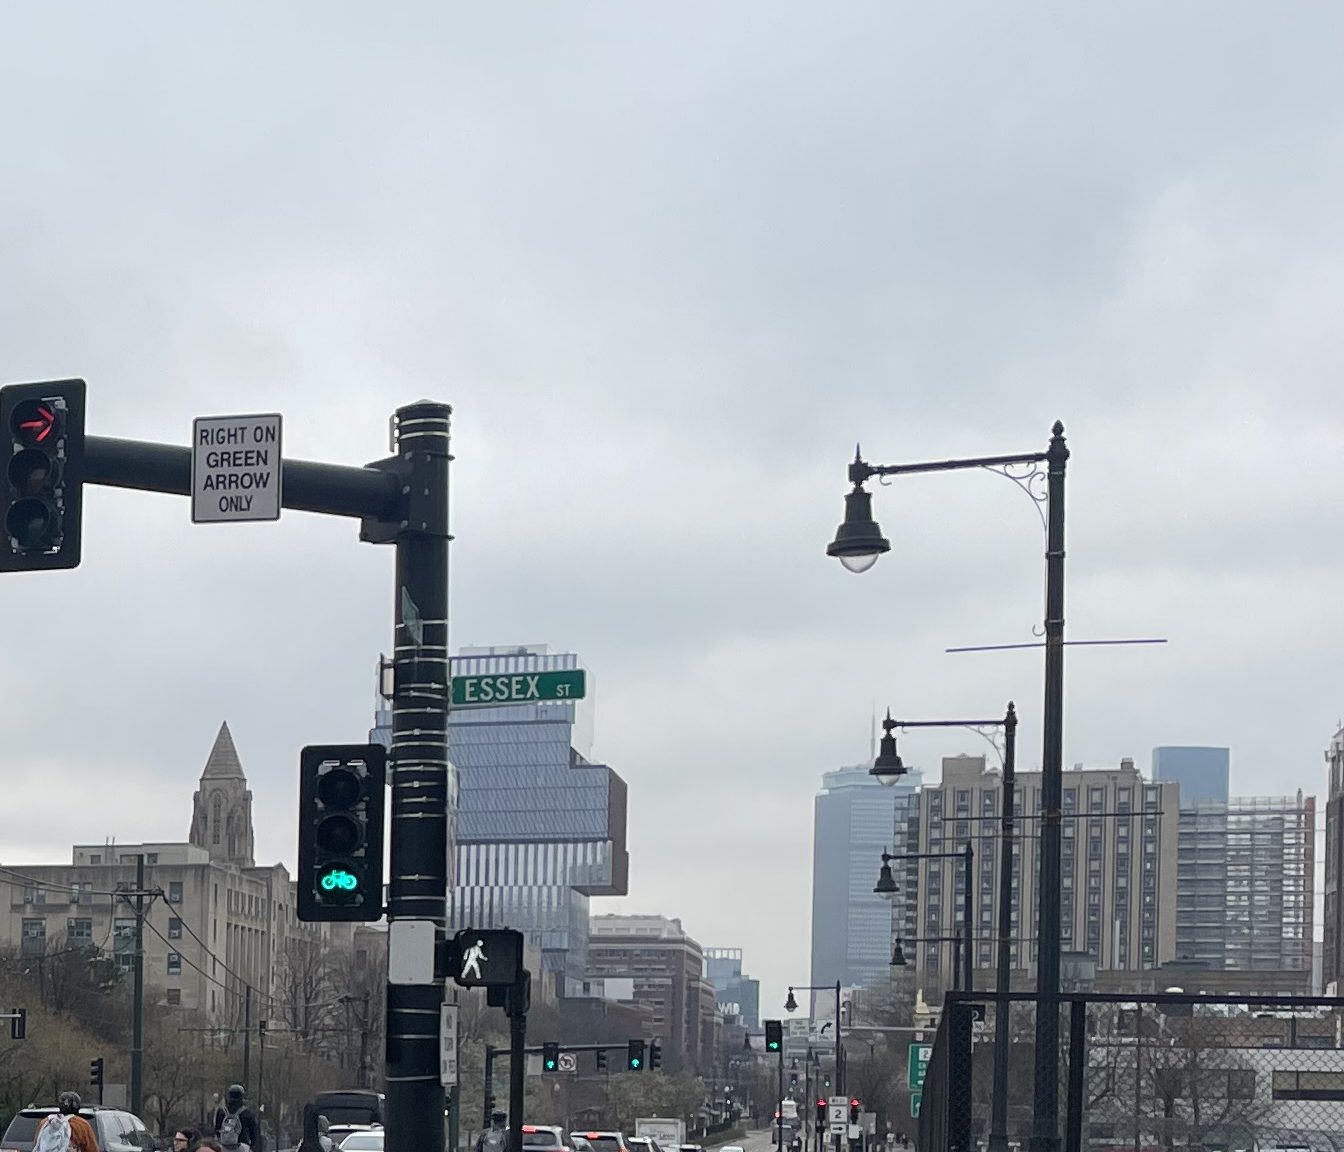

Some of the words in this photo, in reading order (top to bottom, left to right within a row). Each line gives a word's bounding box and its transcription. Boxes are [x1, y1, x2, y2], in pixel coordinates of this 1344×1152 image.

[199, 426, 248, 446] RIGHT
[253, 425, 276, 443] ON
[206, 449, 269, 469] GREEN
[203, 472, 271, 492] ARROW
[218, 494, 254, 513] ONLY
[464, 675, 540, 702] ESSEX
[556, 683, 571, 698] ST
[834, 1109, 842, 1119] 2
